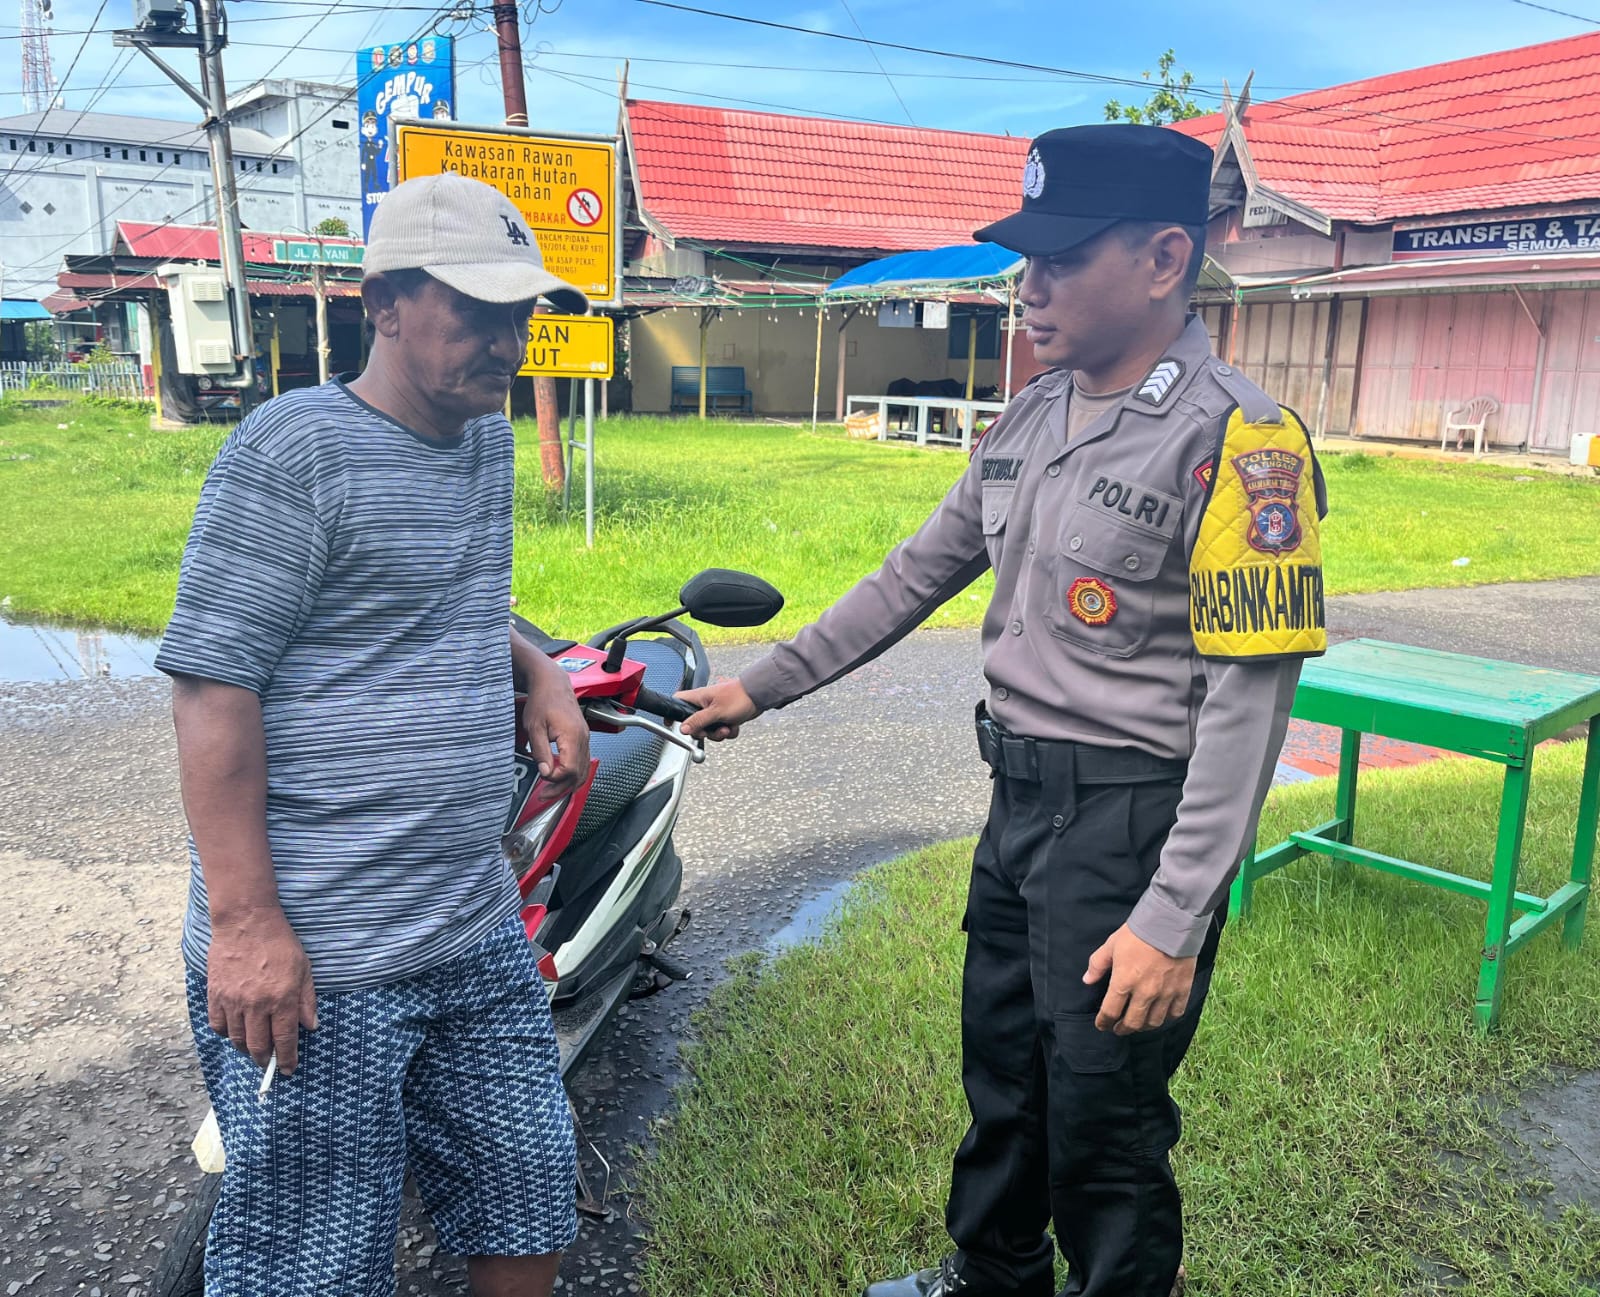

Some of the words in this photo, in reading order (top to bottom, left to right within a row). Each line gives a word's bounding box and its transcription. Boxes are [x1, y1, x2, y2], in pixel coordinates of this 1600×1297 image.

[376, 71, 433, 115] GEMPUR
[445, 141, 515, 162] Kawasan
[523, 147, 573, 167] Rawan
[441, 159, 525, 181] Kebakaran
[533, 167, 577, 185] Hutan
[366, 191, 387, 205] STO
[506, 182, 551, 200] Lahan
[521, 210, 566, 225] MBAKAR
[1409, 222, 1537, 249] TRANSFER
[1545, 221, 1563, 239] &
[294, 247, 310, 259] JL.
[325, 249, 349, 260] YANI
[1507, 238, 1571, 252] SEMUA
[1238, 450, 1298, 468] POLRES
[1088, 476, 1170, 528] POLRI
